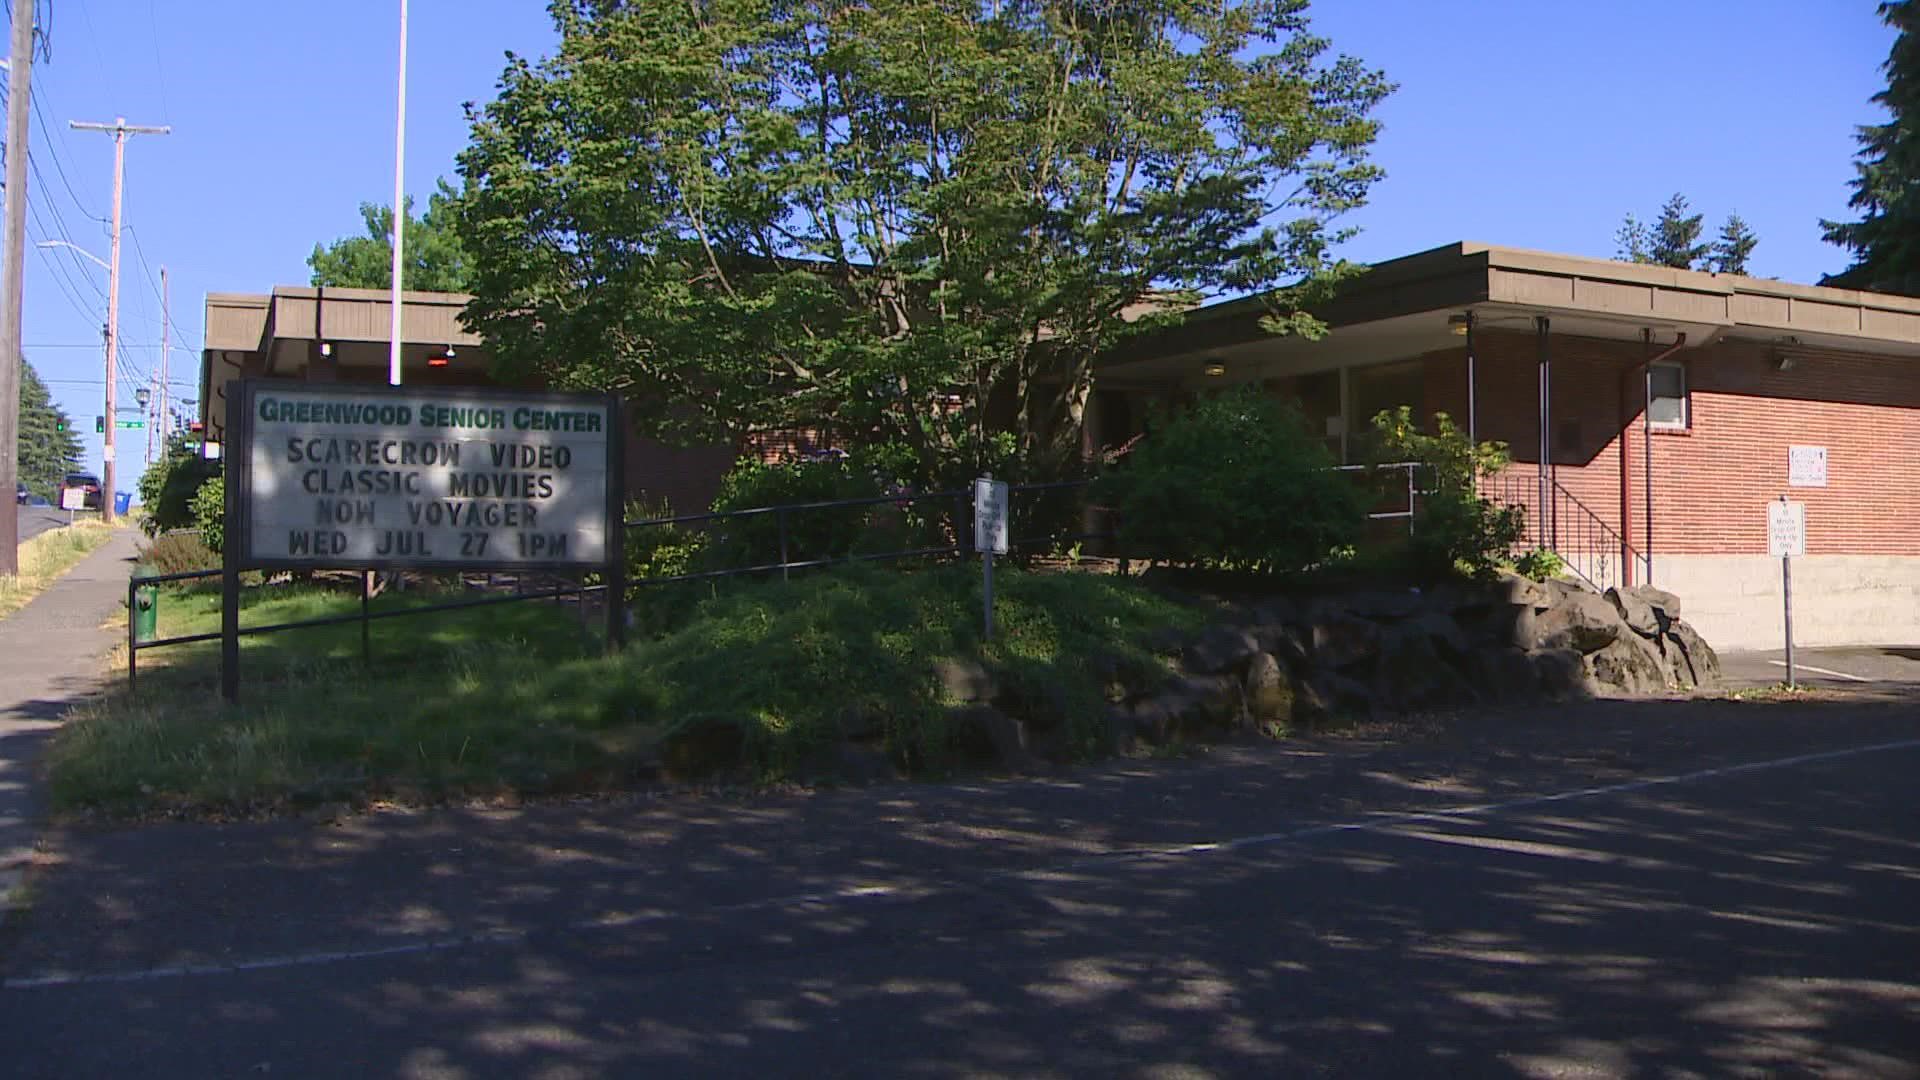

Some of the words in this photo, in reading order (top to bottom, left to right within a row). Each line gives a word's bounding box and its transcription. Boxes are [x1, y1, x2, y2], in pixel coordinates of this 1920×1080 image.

[287, 438, 459, 467] SCARECROW
[490, 443, 571, 469] VIDEO
[303, 469, 420, 495] CLASSIC
[449, 473, 553, 498] MOVIES
[317, 499, 376, 525] NOW
[406, 500, 537, 527] VOYAGER
[289, 529, 347, 555] WED
[375, 530, 431, 556] JUL
[460, 532, 489, 556] 27
[517, 533, 568, 558] 1PM
